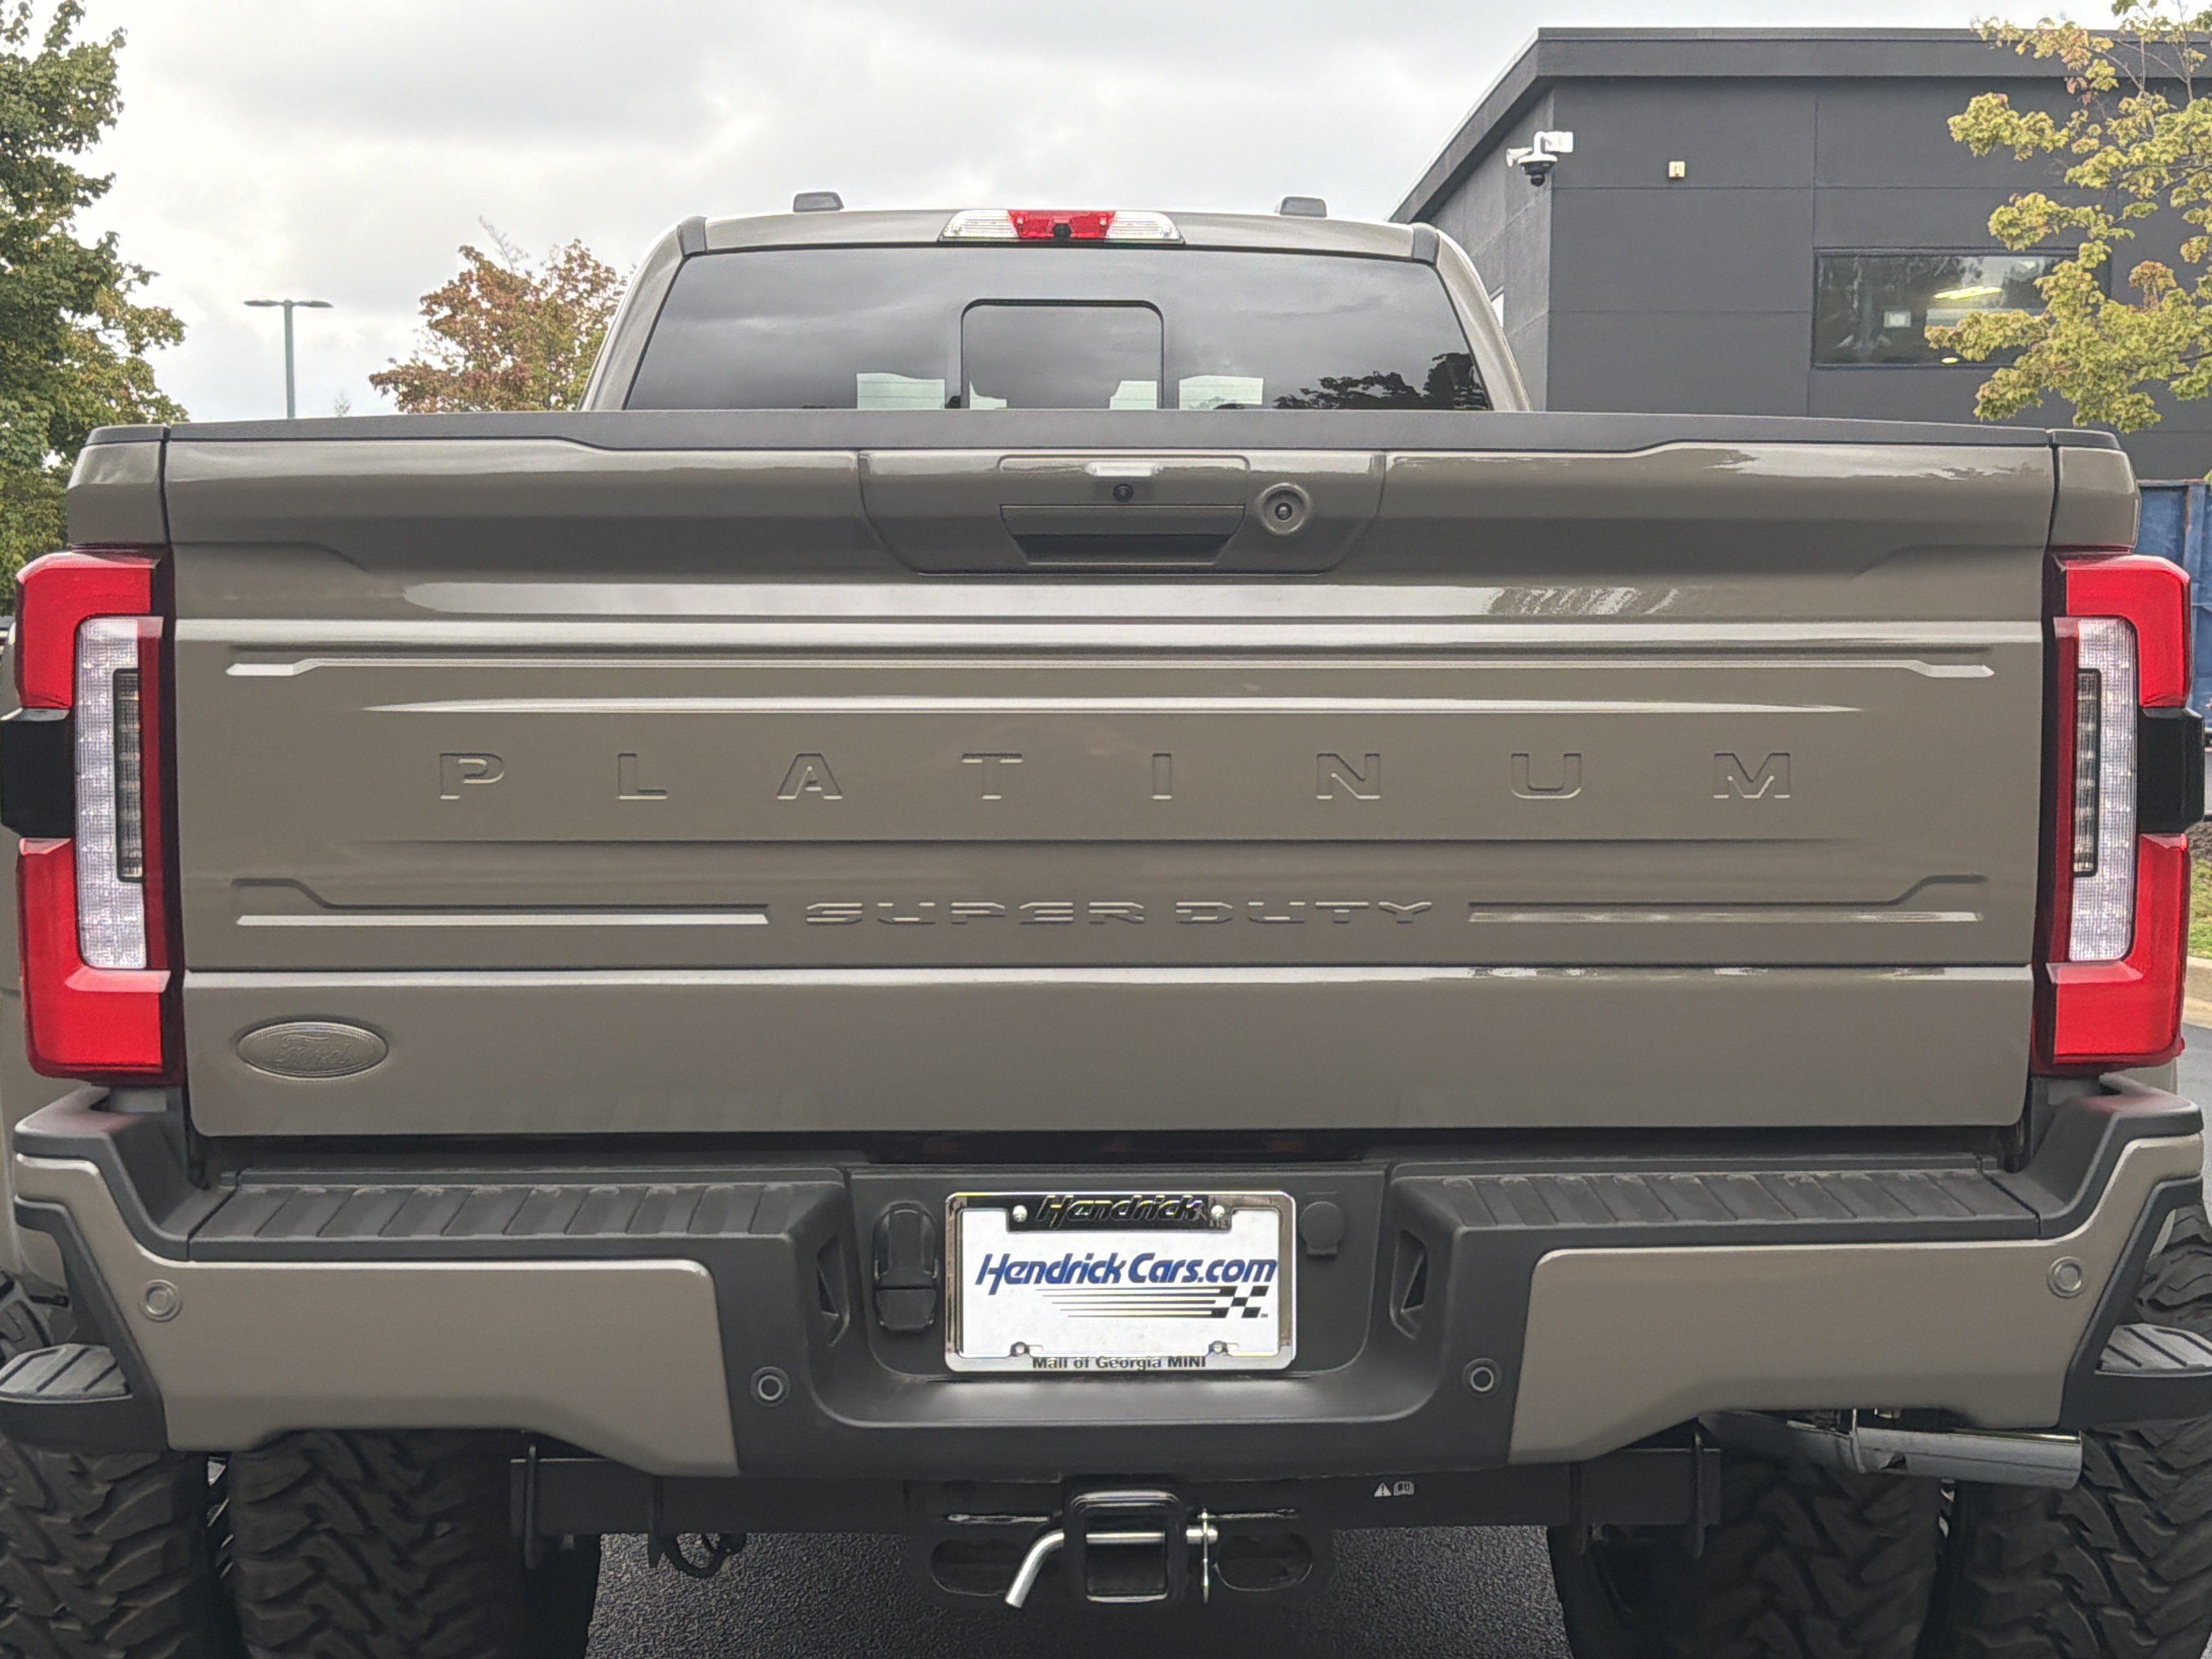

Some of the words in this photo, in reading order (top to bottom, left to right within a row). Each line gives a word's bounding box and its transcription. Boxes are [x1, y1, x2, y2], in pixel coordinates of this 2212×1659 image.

[439, 752, 1791, 800] PLATINUM
[805, 900, 1146, 925] SUPER
[1175, 900, 1433, 925] DUTY
[274, 1034, 352, 1066] Ford
[1036, 1194, 1207, 1229] Hendrick
[1032, 1357, 1068, 1369] Mall
[1073, 1357, 1089, 1369] of
[1096, 1356, 1162, 1371] Georgia
[1167, 1355, 1206, 1368] MINI
